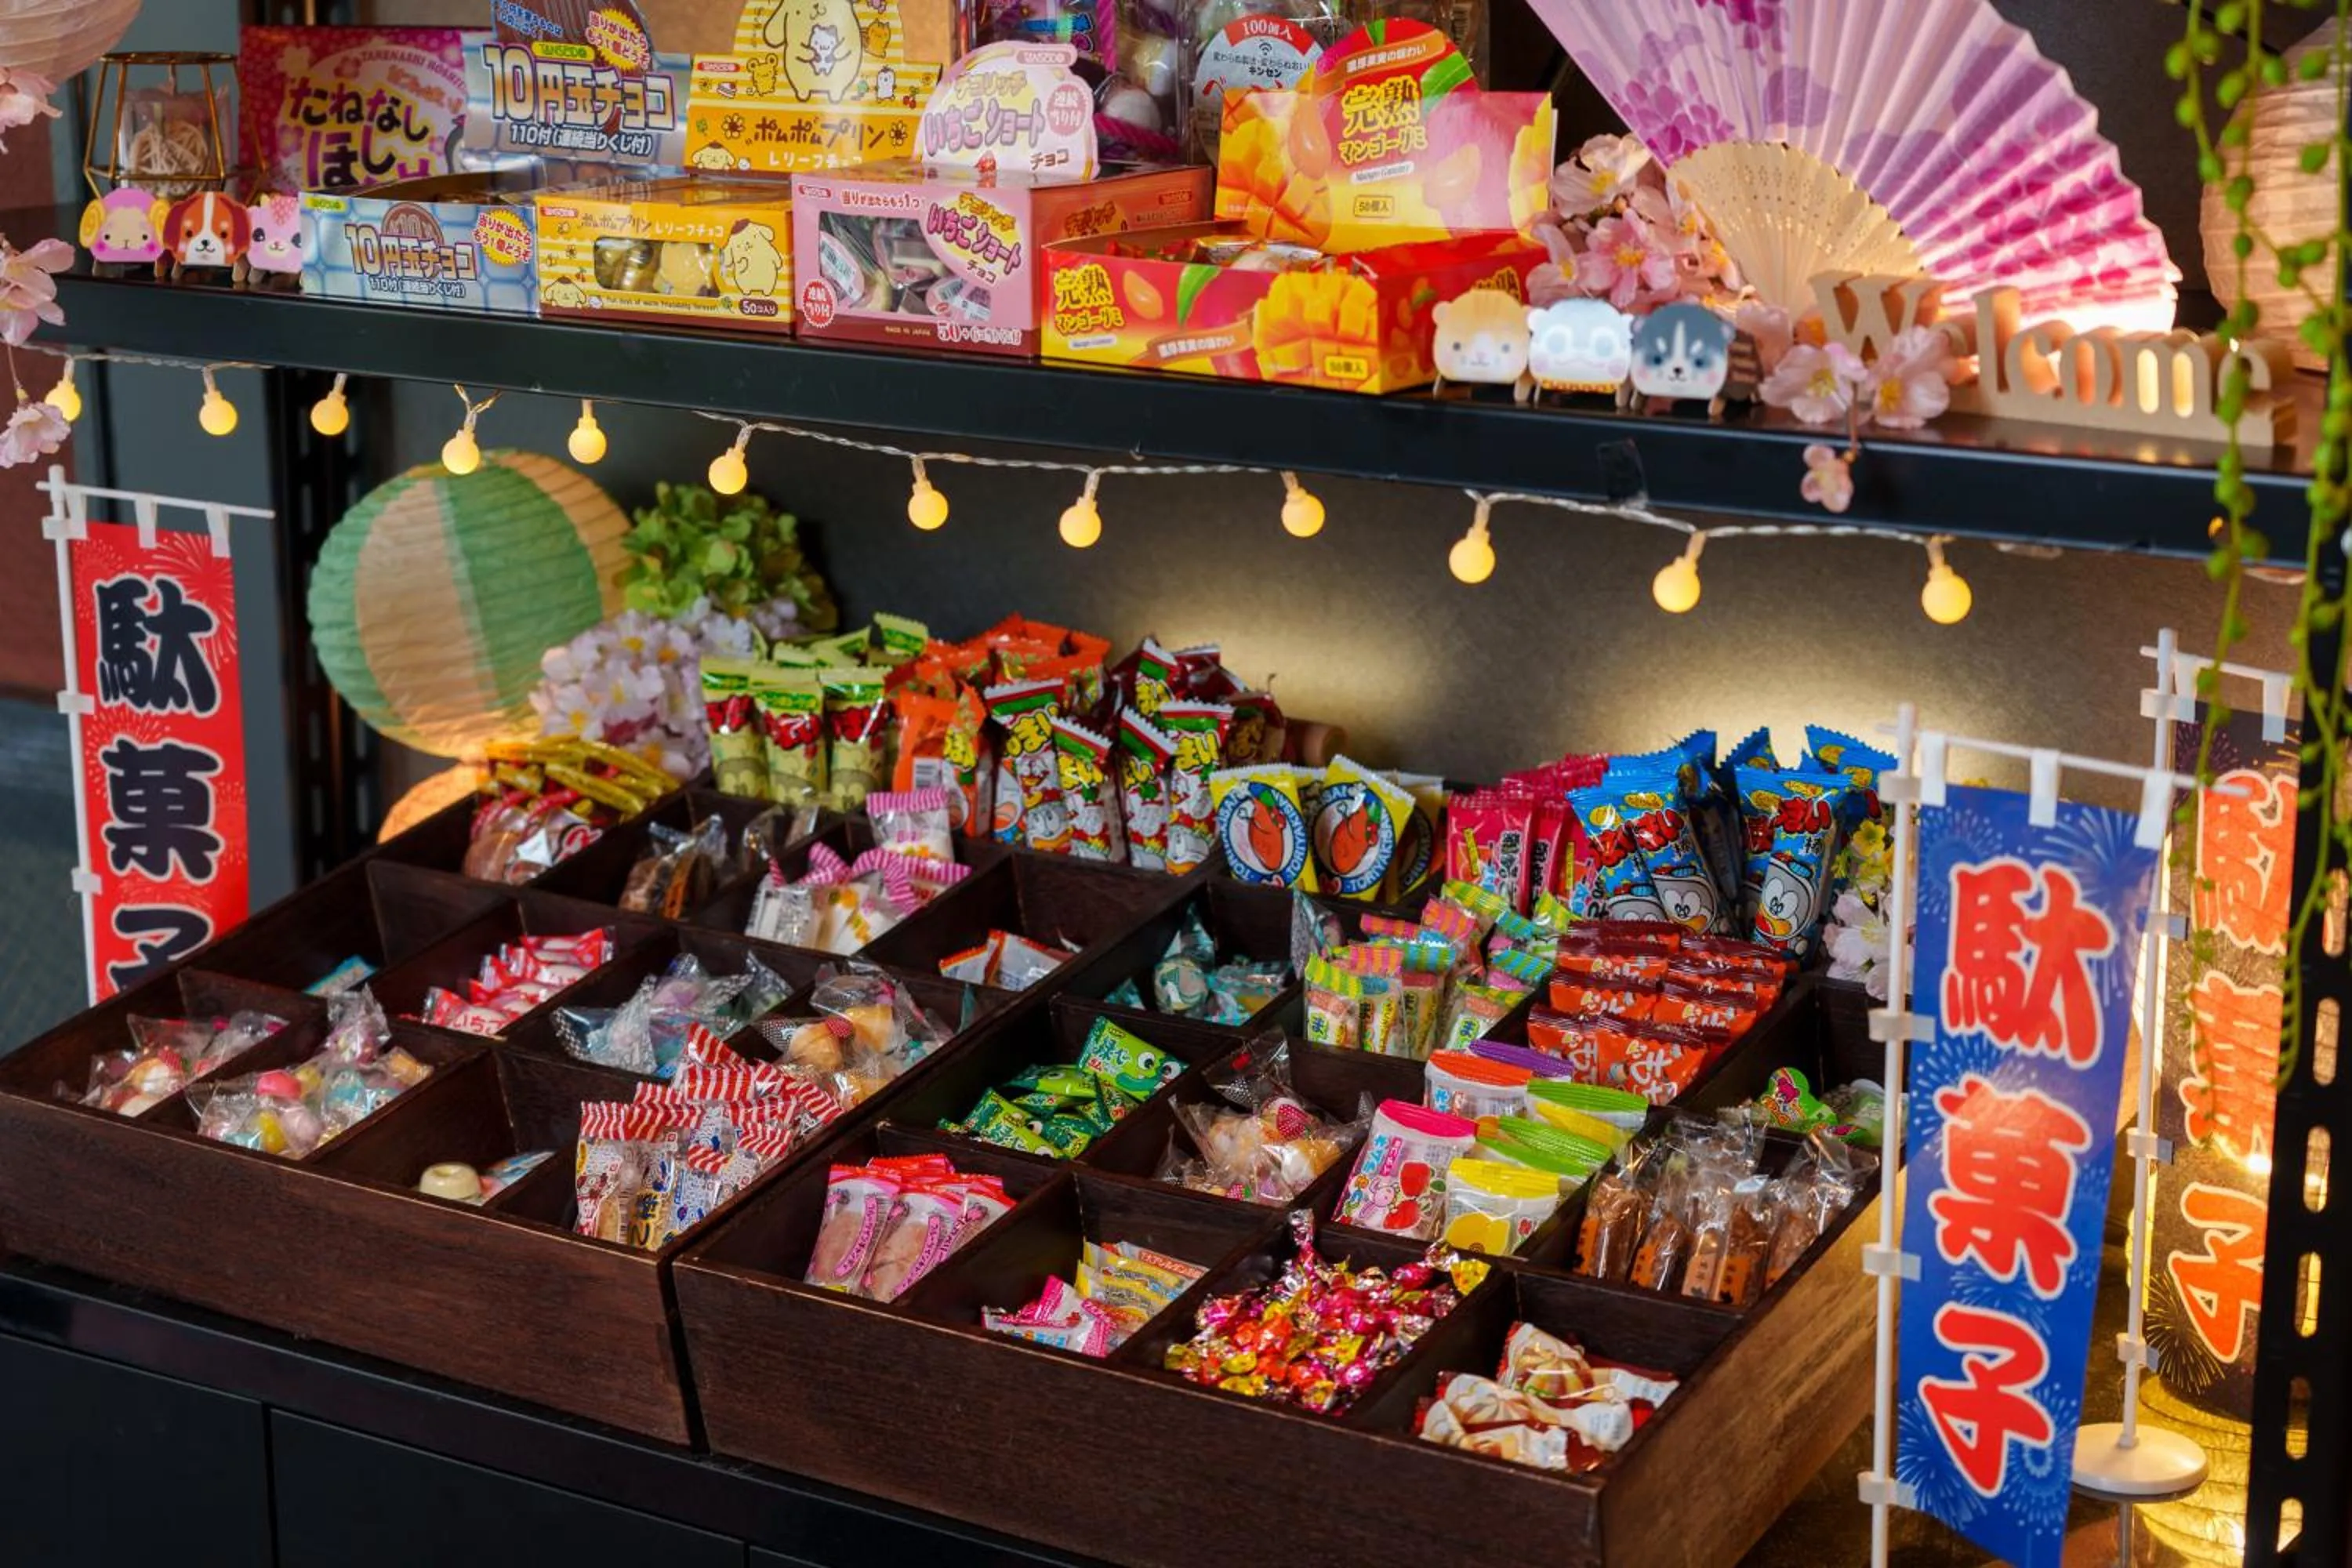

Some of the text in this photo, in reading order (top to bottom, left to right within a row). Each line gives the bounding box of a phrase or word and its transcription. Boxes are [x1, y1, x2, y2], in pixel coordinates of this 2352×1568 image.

[288, 76, 430, 143] たねなし
[483, 44, 676, 132] 10円玉チョコ
[1342, 76, 1420, 137] 完熟
[753, 117, 885, 152] ポムポムプリン
[1339, 127, 1428, 165] マンゴーグミ
[1030, 148, 1069, 170] チョコ
[344, 223, 477, 281] 10円玉チョコ
[654, 223, 724, 238] レリーフチョコ
[927, 202, 1022, 274] いちごショート
[966, 260, 997, 285] チョコ
[1054, 264, 1114, 312] 完熟
[1055, 306, 1125, 336] マンゴーグミ
[1919, 856, 2117, 1499] 駄菓子
